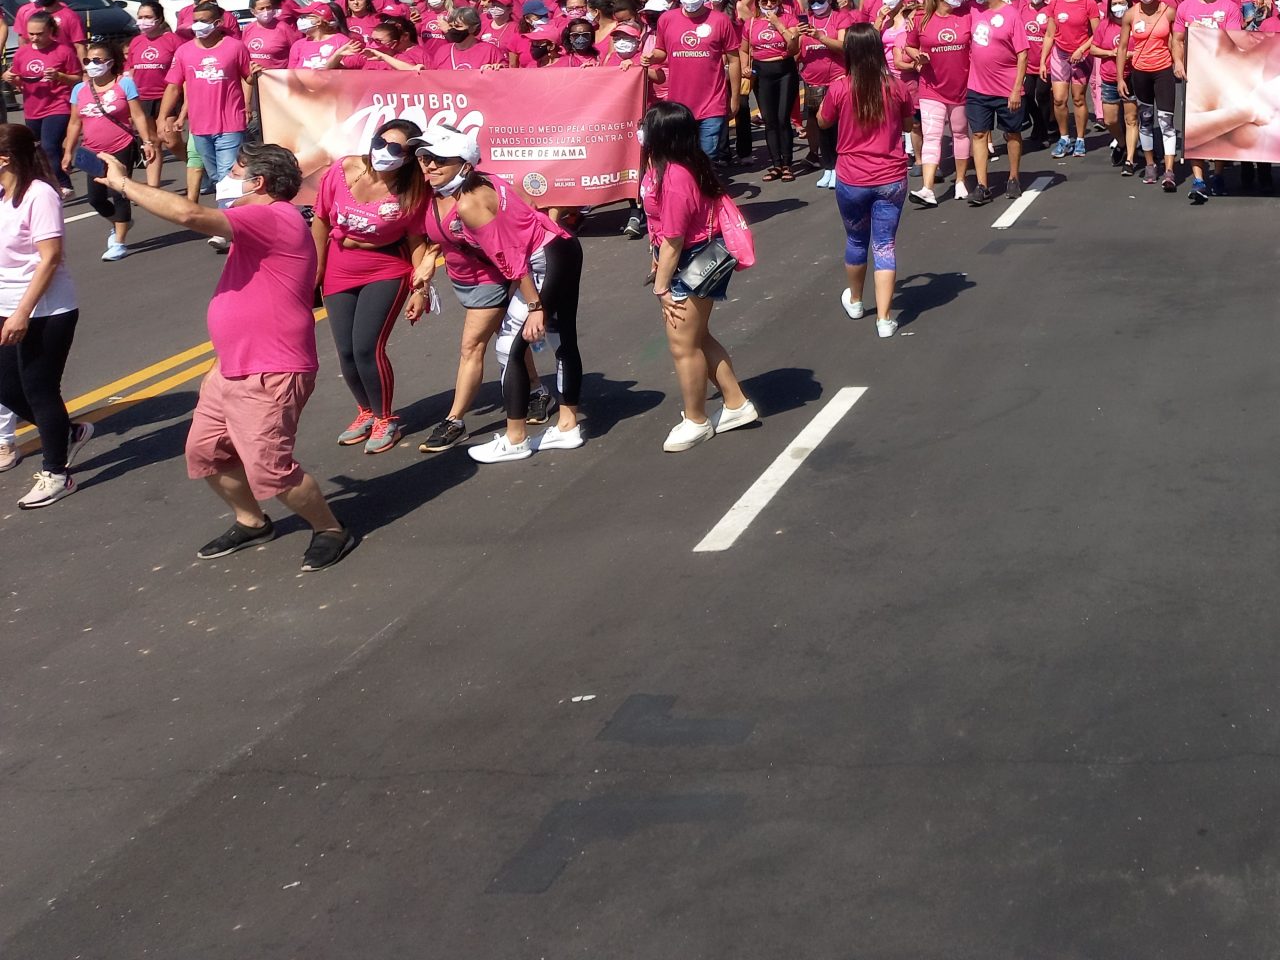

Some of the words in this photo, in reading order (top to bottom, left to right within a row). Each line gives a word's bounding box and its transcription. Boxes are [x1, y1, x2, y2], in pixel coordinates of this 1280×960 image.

[372, 93, 468, 110] OUTUBRO
[489, 126, 525, 135] TROQUE
[528, 125, 535, 133] O
[538, 125, 564, 133] MEDO
[566, 124, 585, 133] PELA
[490, 137, 521, 145] VAMOS
[556, 136, 582, 144] LUTAR
[585, 133, 623, 143] CONTRA
[627, 131, 634, 139] O
[493, 148, 534, 158] CÂNCER
[537, 149, 549, 157] DE
[552, 148, 585, 157] MAMA
[581, 169, 639, 187] BARUER
